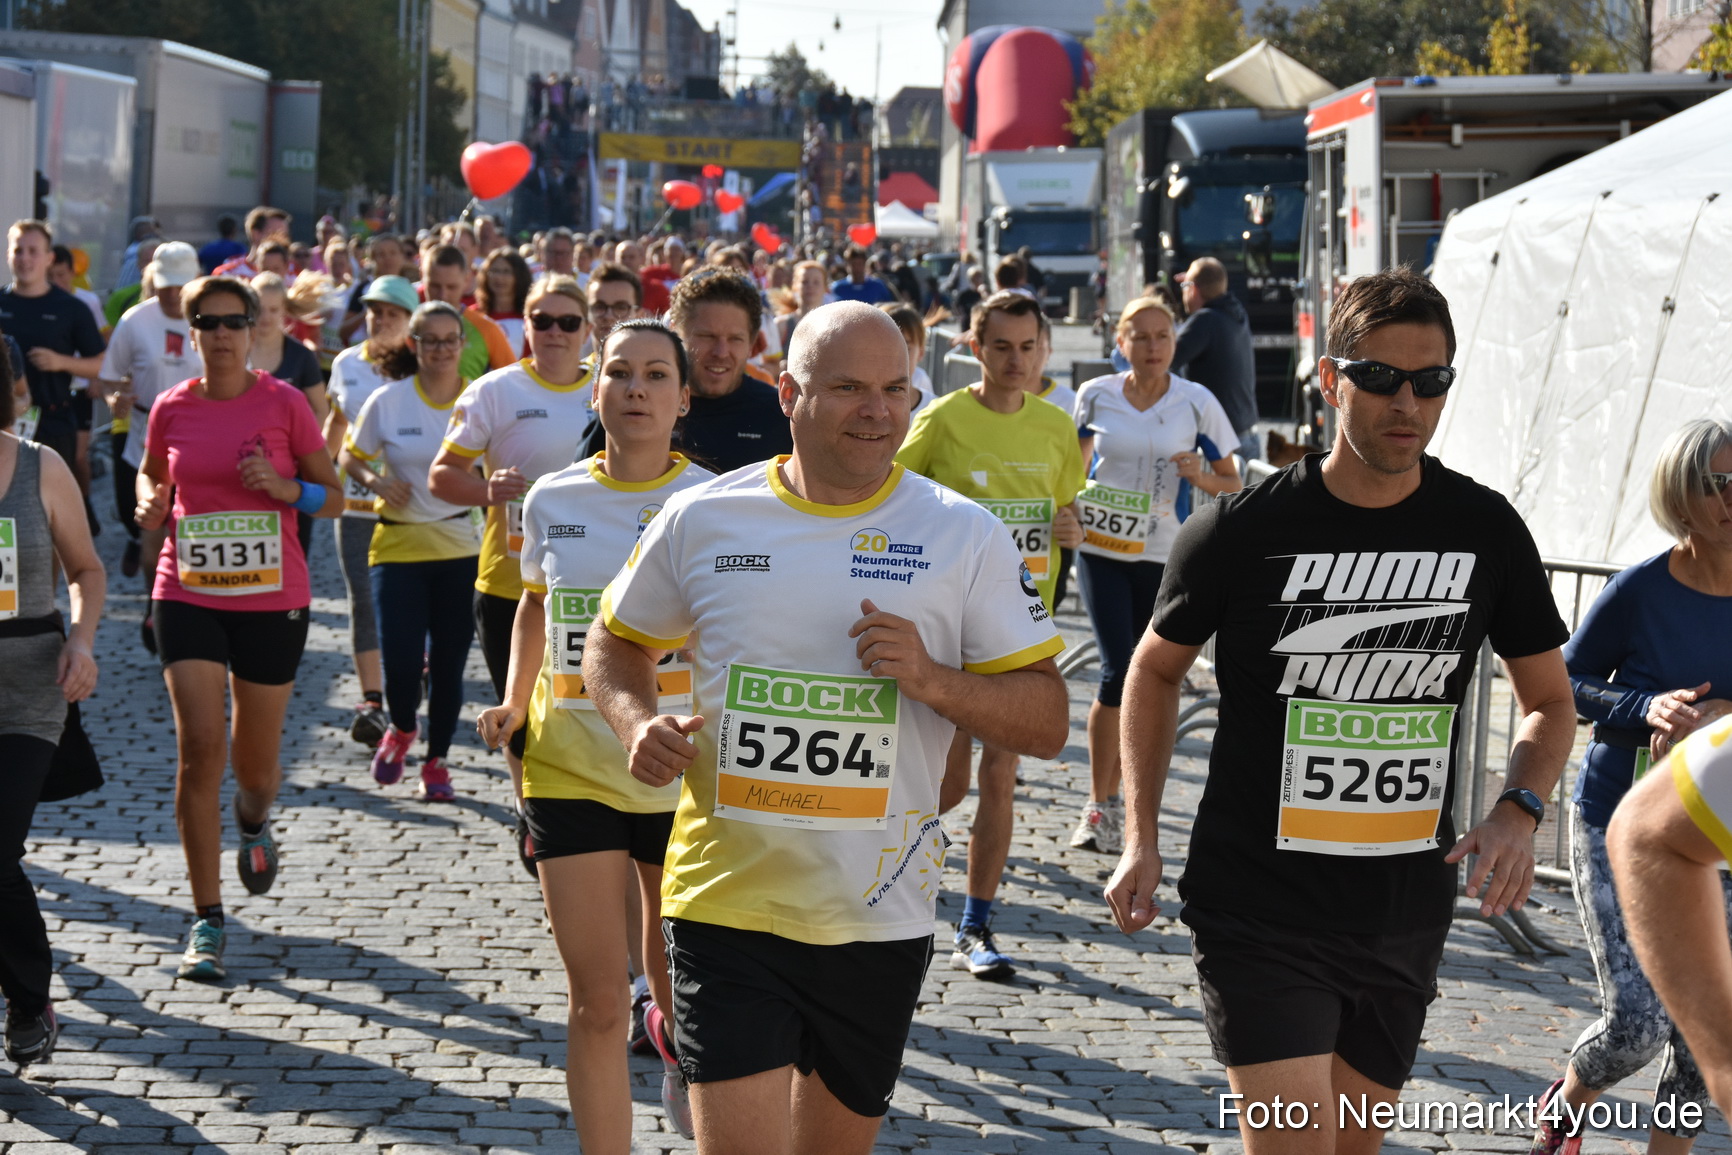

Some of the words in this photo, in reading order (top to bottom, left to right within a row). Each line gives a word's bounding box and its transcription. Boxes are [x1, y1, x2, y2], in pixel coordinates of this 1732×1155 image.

[665, 141, 733, 159] START
[184, 515, 272, 536] BOCK
[548, 525, 586, 536] BOCK
[1084, 505, 1139, 536] 5267
[189, 541, 266, 568] 5131
[854, 533, 887, 553] 20
[891, 545, 920, 553] JAHRE
[715, 554, 771, 568] BOCK
[852, 554, 931, 570] Neumarkter
[199, 573, 261, 585] SANDRA
[850, 567, 915, 584] Stadtlauf
[1280, 551, 1477, 602] PUMA
[1032, 611, 1050, 623] Neu
[1276, 652, 1461, 702] PUMA
[737, 672, 884, 717] BOCK
[1300, 706, 1441, 744] BOCK
[735, 721, 875, 778] 5264
[1302, 755, 1431, 803] 5265
[744, 784, 842, 811] MICHAEL
[866, 882, 893, 907] 14./15.
[891, 834, 922, 883] September
[920, 818, 940, 837] 2019
